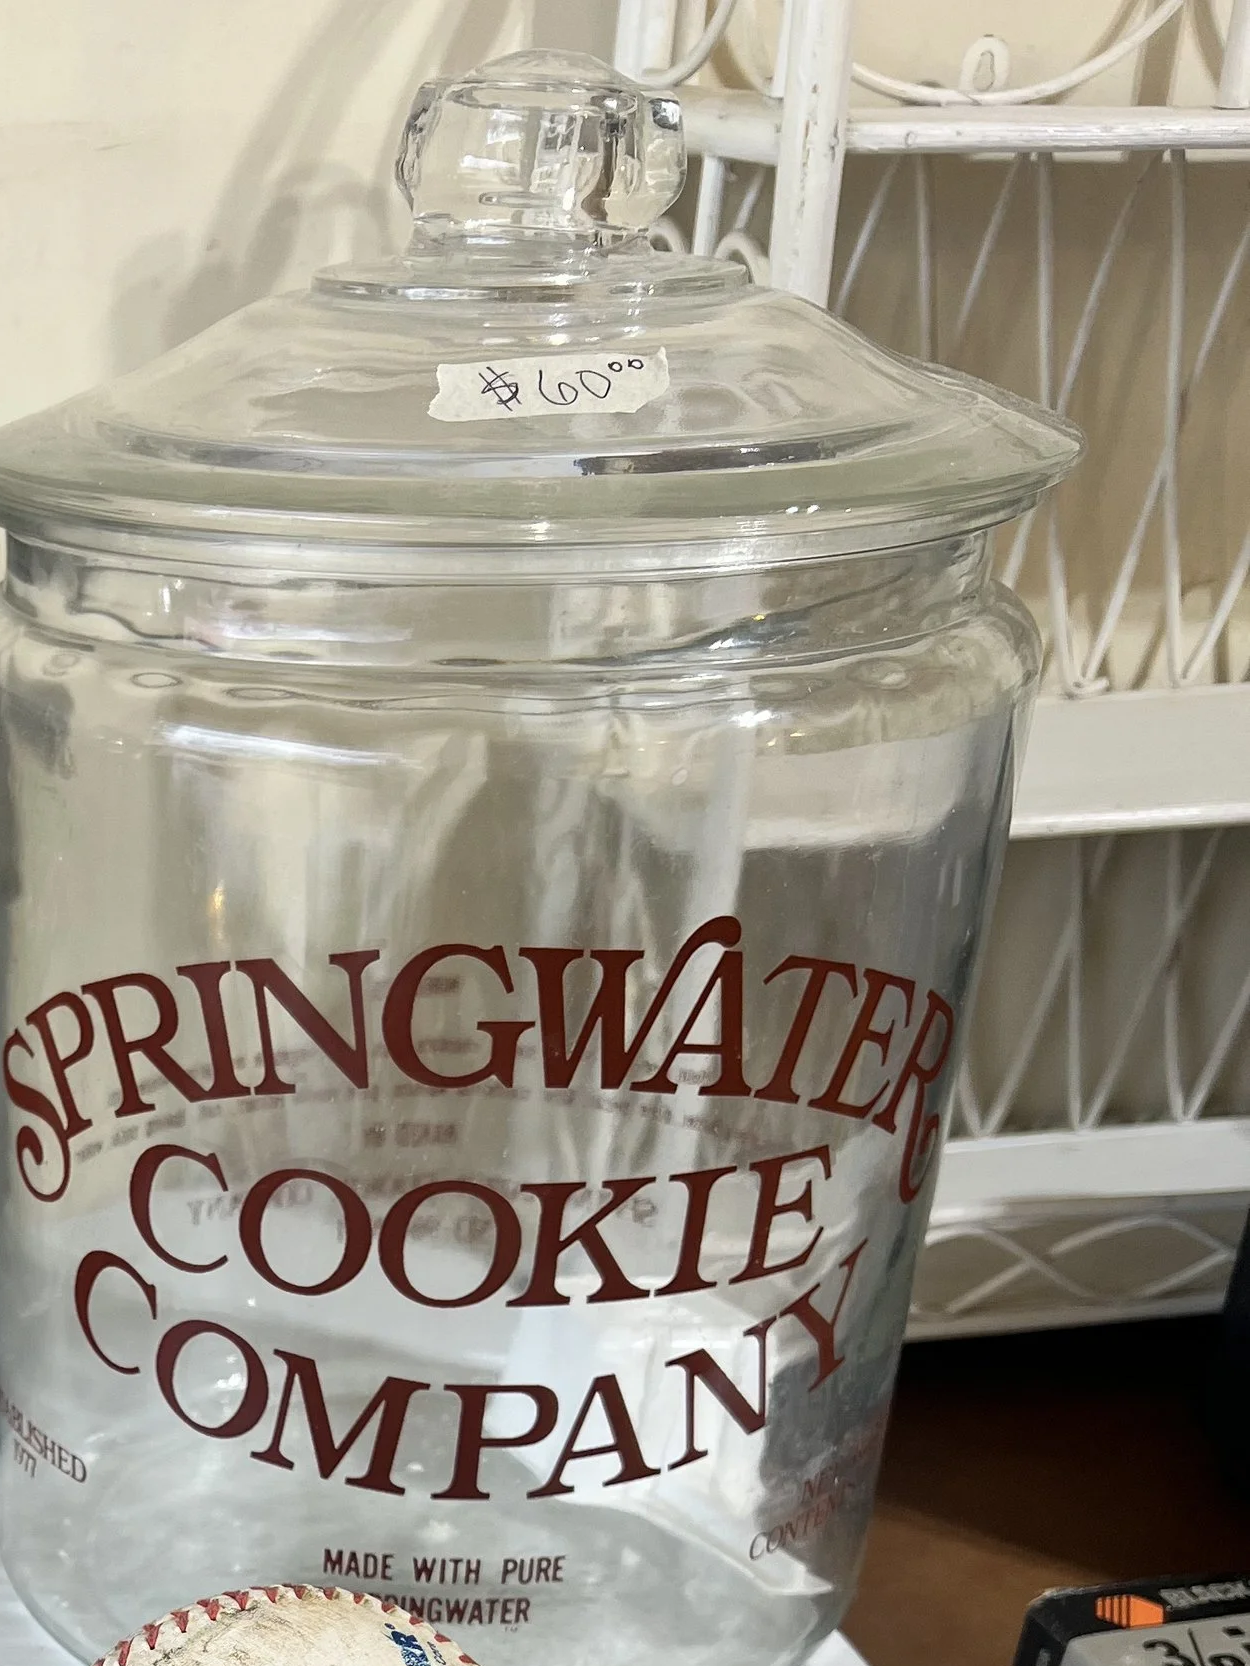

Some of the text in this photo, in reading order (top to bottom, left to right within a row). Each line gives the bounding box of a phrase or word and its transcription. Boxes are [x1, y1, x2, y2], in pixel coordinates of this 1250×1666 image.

[2, 915, 955, 1203] SPRINGWATER
[128, 1144, 841, 1308] COOKIE
[74, 1239, 869, 1501] COMPANY
[323, 1548, 566, 1585] MADE WITH PURE
